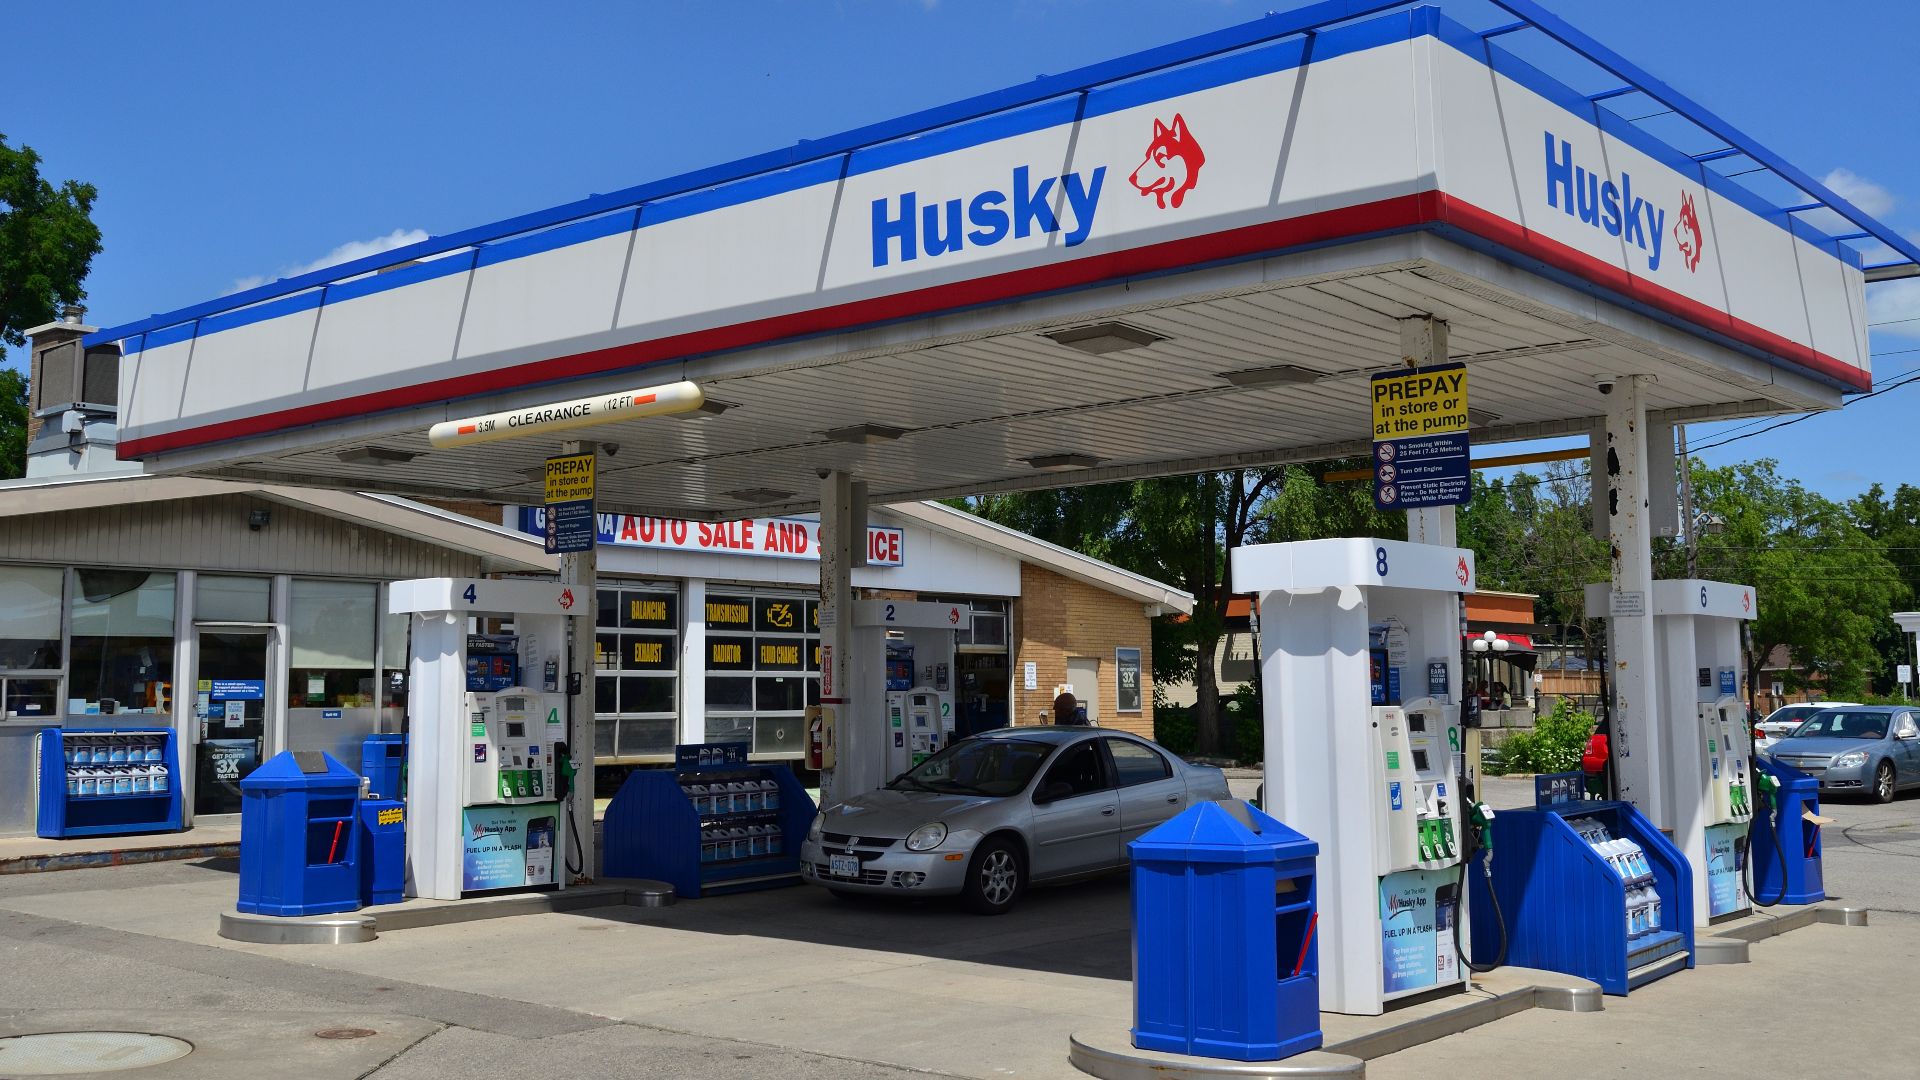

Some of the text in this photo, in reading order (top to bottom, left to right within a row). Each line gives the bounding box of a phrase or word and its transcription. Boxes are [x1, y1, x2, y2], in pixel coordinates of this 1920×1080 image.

[1545, 130, 1665, 271] Husky
[871, 164, 1107, 268] Husky
[1374, 373, 1463, 402] PREPAY
[1382, 398, 1459, 417] in store or
[478, 419, 495, 433] 3.5M
[508, 403, 591, 427] CLEARANCE
[1376, 414, 1467, 434] at the pump
[1408, 442, 1433, 450] Smoking
[547, 458, 592, 476] PREPAY
[549, 476, 590, 486] in store or
[1439, 480, 1466, 488] Electricity
[546, 487, 592, 499] at the pump
[621, 515, 688, 545] AUTO
[698, 520, 753, 550] SALE
[764, 522, 808, 554] AND
[1375, 547, 1388, 577] 8
[463, 584, 477, 604] 4
[1700, 586, 1708, 608] 6
[631, 600, 667, 621] BALANCING
[705, 602, 749, 623] TRANSMISSION
[886, 604, 896, 622] 2
[634, 642, 663, 663] EXHAUST
[713, 643, 741, 663] RADIATOR
[760, 645, 776, 663] FLUID
[777, 645, 799, 665] CHANGE
[1123, 671, 1135, 683] 3X
[547, 708, 560, 723] 4
[941, 703, 950, 717] 2
[1448, 727, 1460, 751] 8
[216, 758, 240, 774] 3X
[505, 825, 517, 833] App
[466, 846, 481, 854] FUEL
[504, 843, 522, 851] FLASH
[1417, 897, 1427, 907] App
[1384, 929, 1397, 939] FUEL
[1406, 927, 1412, 935] IN
[1417, 924, 1433, 935] FLASH
